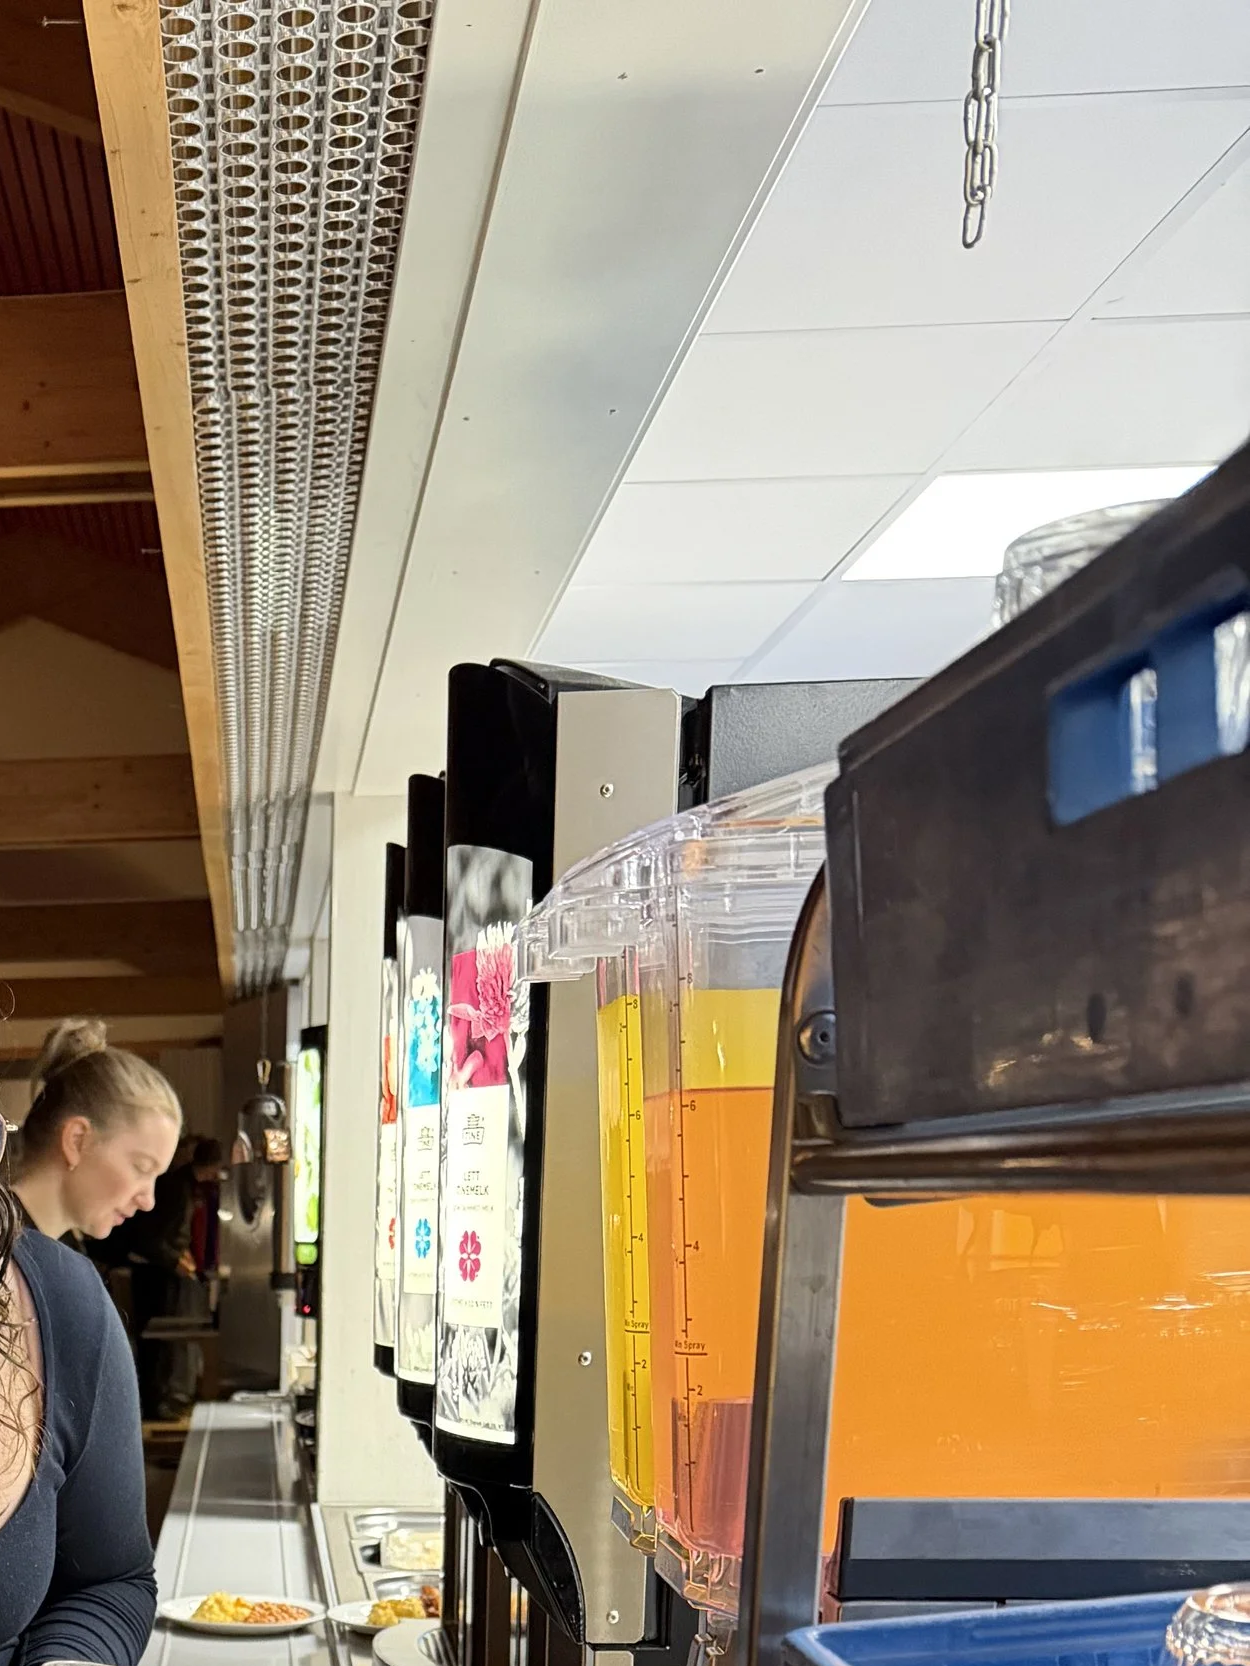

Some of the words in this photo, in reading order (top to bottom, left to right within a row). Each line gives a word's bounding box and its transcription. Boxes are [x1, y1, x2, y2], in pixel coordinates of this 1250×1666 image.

[690, 1100, 696, 1112] 6
[635, 1110, 641, 1120] 6
[638, 1232, 644, 1242] 4
[693, 1240, 699, 1252] 4
[631, 1320, 649, 1330] Spray
[684, 1340, 706, 1351] Spray
[641, 1359, 647, 1369] 2
[697, 1384, 703, 1396] 2
